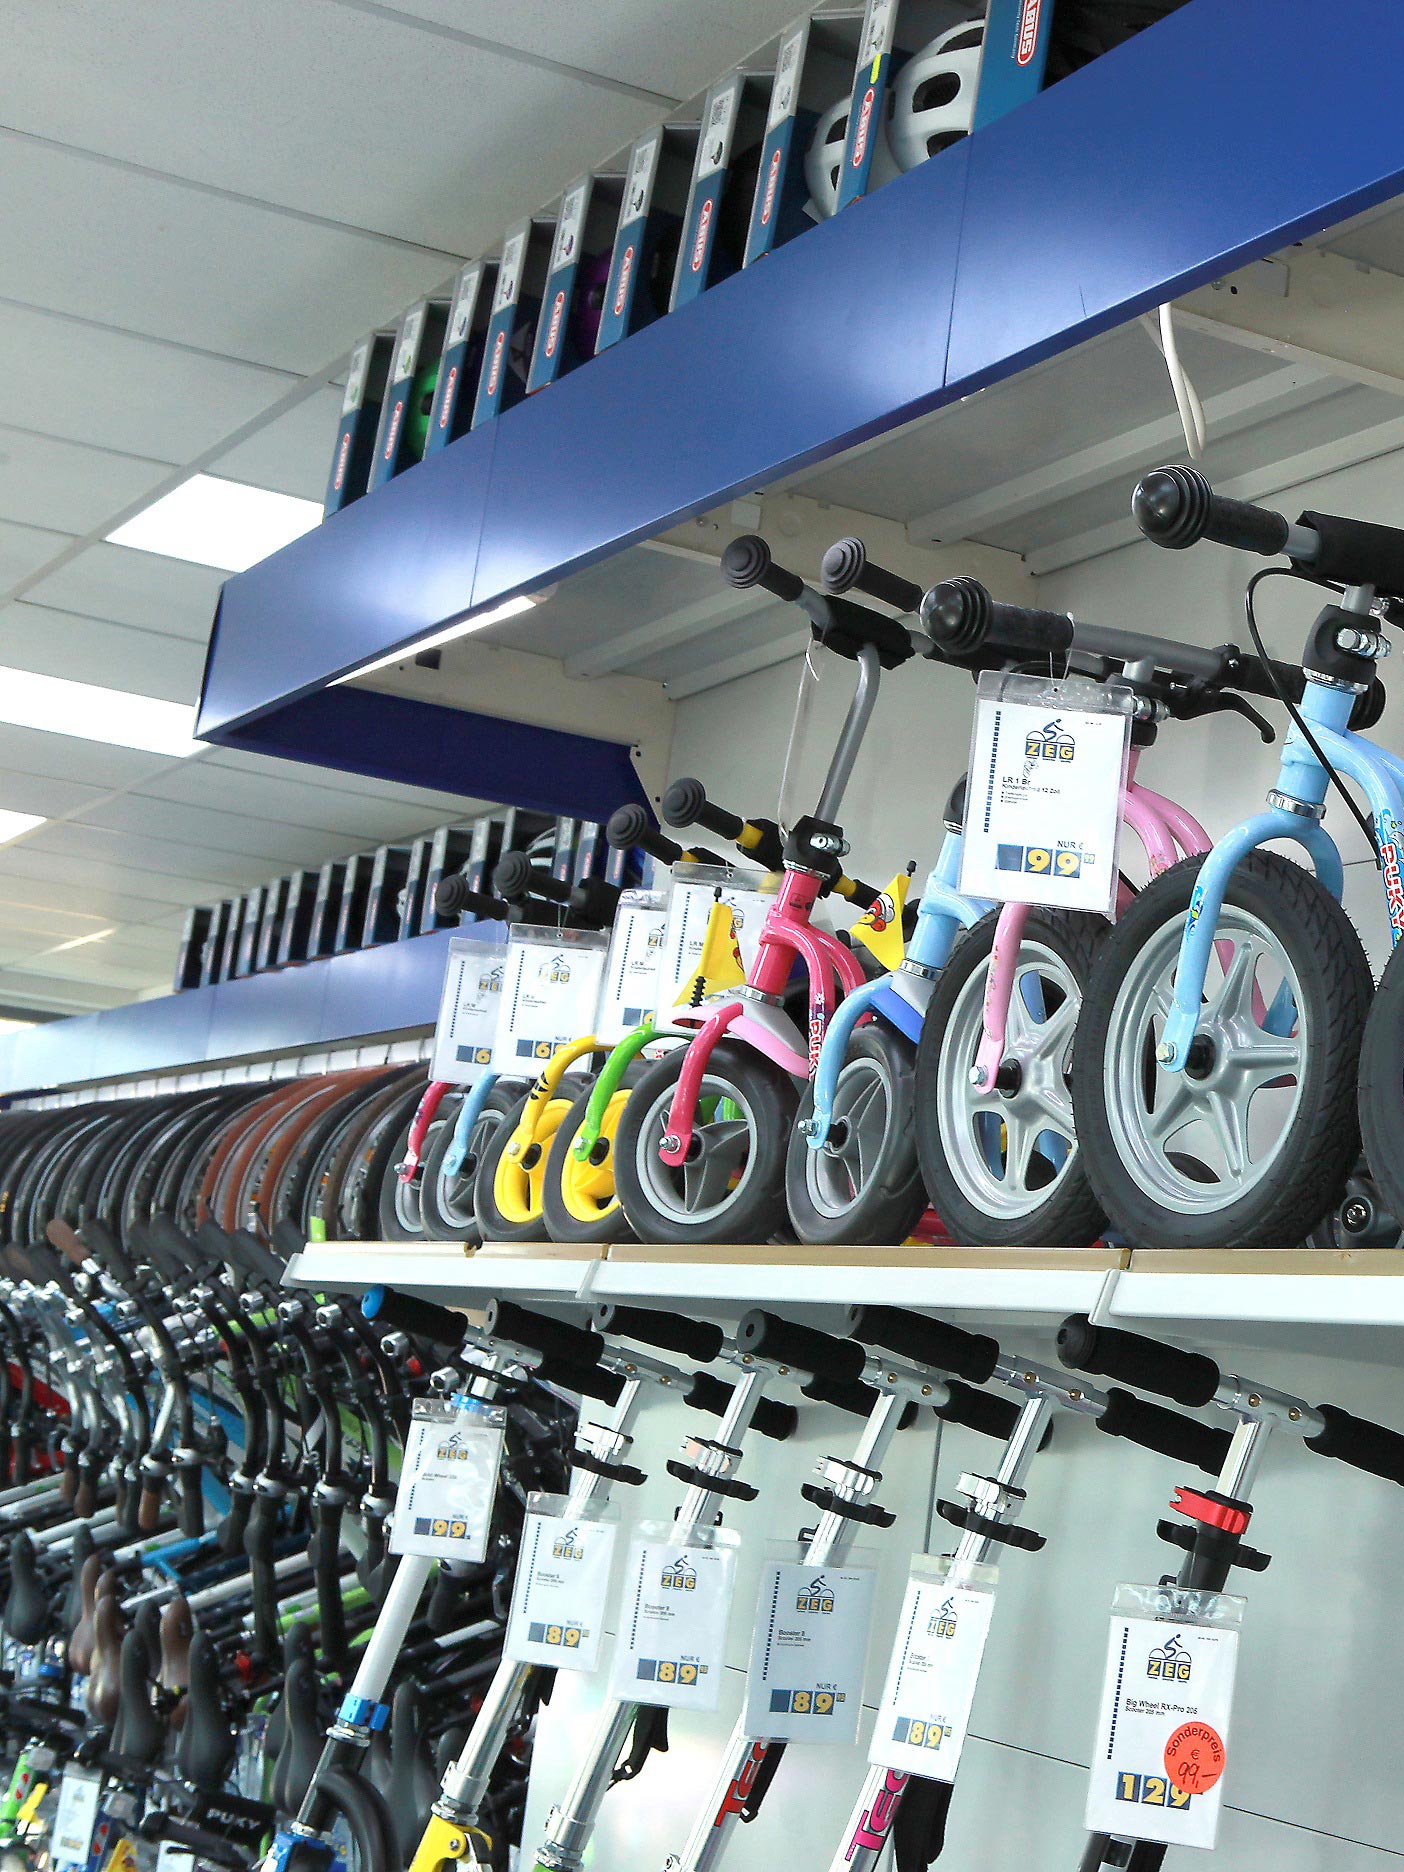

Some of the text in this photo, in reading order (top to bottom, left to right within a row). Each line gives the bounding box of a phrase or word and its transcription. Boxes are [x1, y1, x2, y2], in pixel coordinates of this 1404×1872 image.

[1026, 742, 1074, 760] ZEG
[1057, 840, 1076, 849] NUR
[1028, 849, 1080, 875] 99
[809, 1020, 822, 1082] PUK
[433, 1519, 467, 1538] 99
[662, 1575, 696, 1589] ZEG
[798, 1598, 834, 1612] ZEG
[547, 1625, 580, 1647] 89
[659, 1662, 697, 1684] 89
[1148, 1660, 1191, 1680] ZEG
[794, 1692, 833, 1713] 89
[1126, 1698, 1137, 1708] Big
[1139, 1699, 1159, 1709] Wheel
[1160, 1702, 1184, 1713] RX-Pro
[910, 1721, 942, 1747] 89
[1166, 1726, 1222, 1763] Sonderpreis
[1190, 1749, 1200, 1760] €
[1122, 1774, 1191, 1808] 129
[206, 1807, 262, 1830] PUKY
